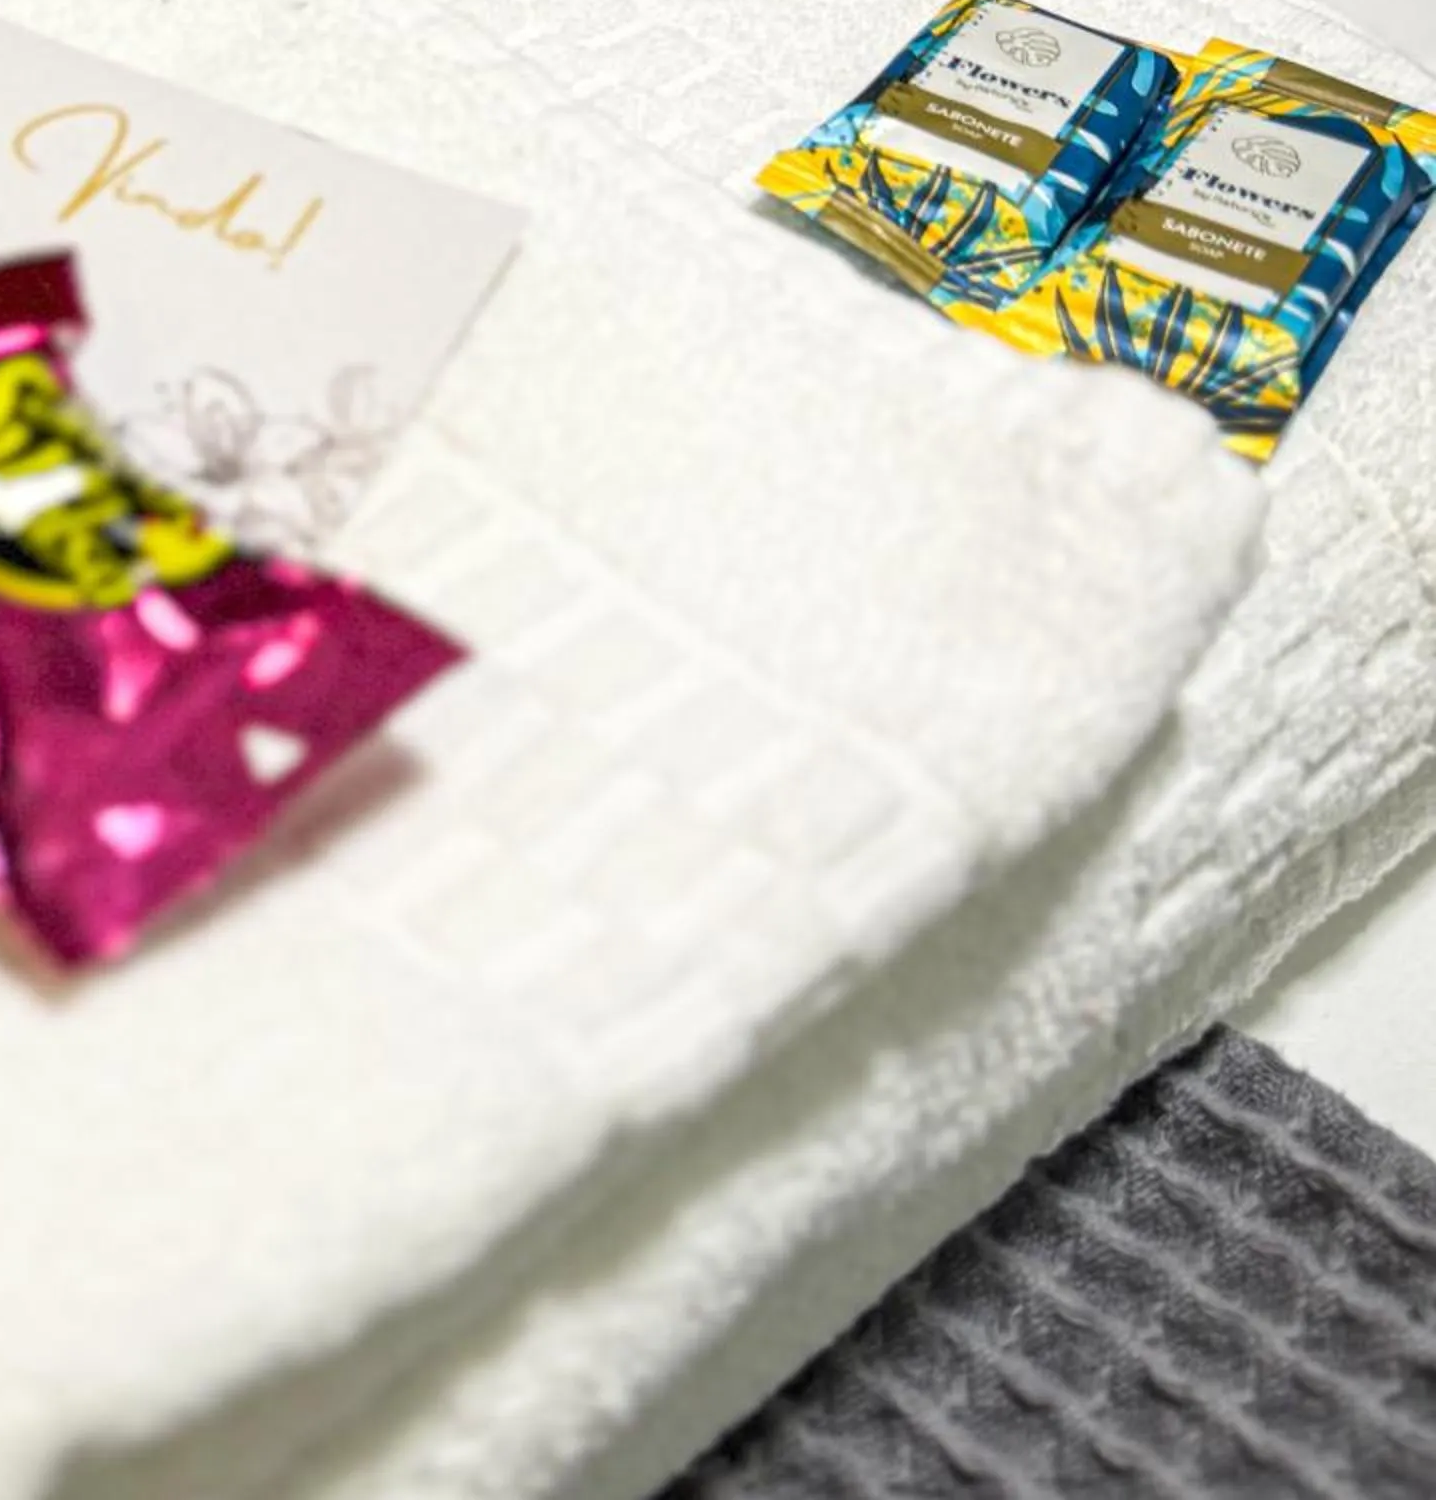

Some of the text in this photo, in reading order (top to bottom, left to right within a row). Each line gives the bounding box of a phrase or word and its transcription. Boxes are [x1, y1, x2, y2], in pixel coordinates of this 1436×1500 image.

[943, 55, 1071, 109] Flowers
[925, 102, 1024, 148] SABONETE
[11, 104, 324, 270] Vindo!
[1180, 166, 1316, 221] Flowers
[1162, 216, 1267, 262] SABONETE
